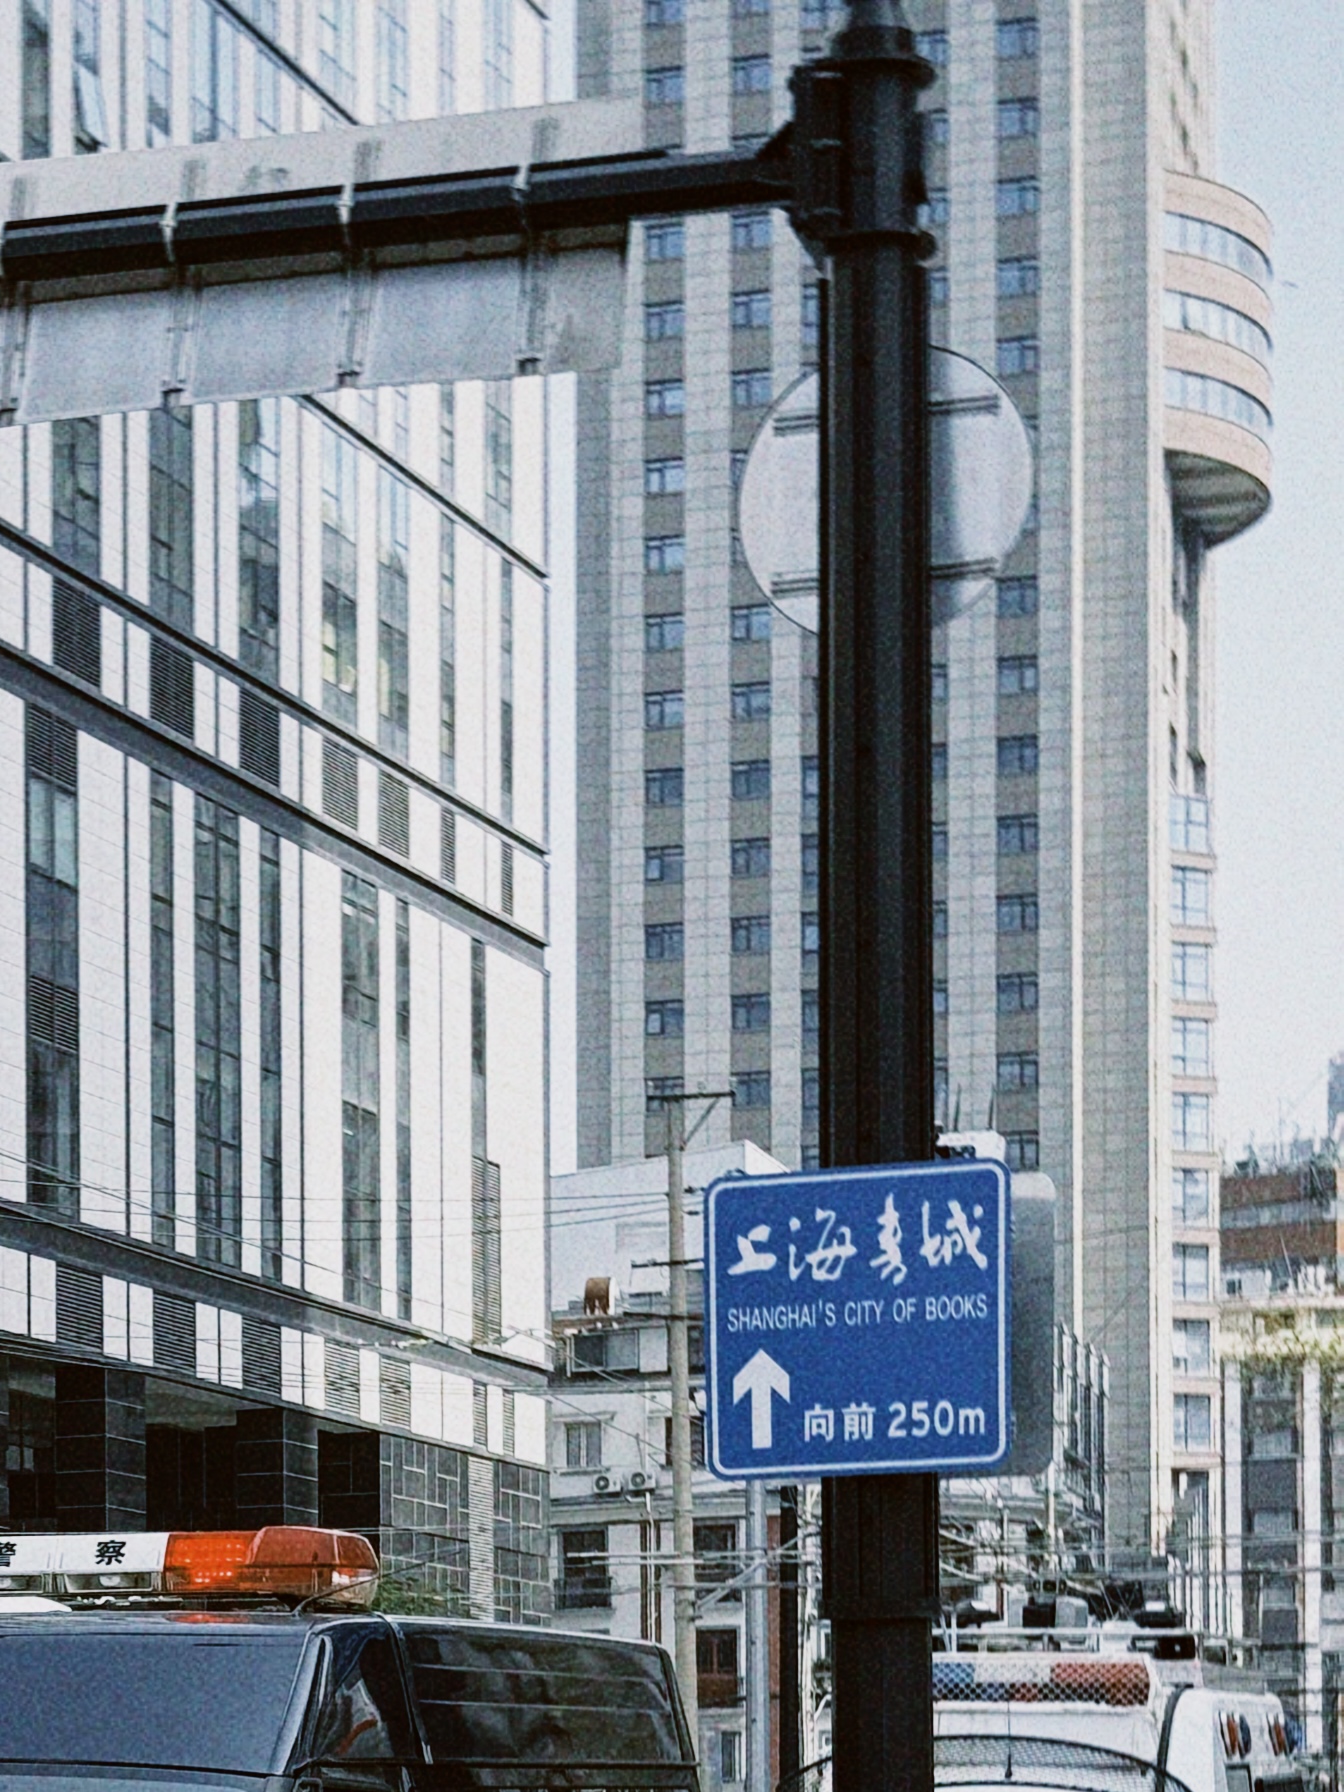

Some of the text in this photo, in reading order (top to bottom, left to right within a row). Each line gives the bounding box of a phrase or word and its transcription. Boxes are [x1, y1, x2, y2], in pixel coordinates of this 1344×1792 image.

[727, 1293, 987, 1332] SHANGHAI'S CITY OF BOOKS
[804, 1401, 986, 1442] 向前 250m
